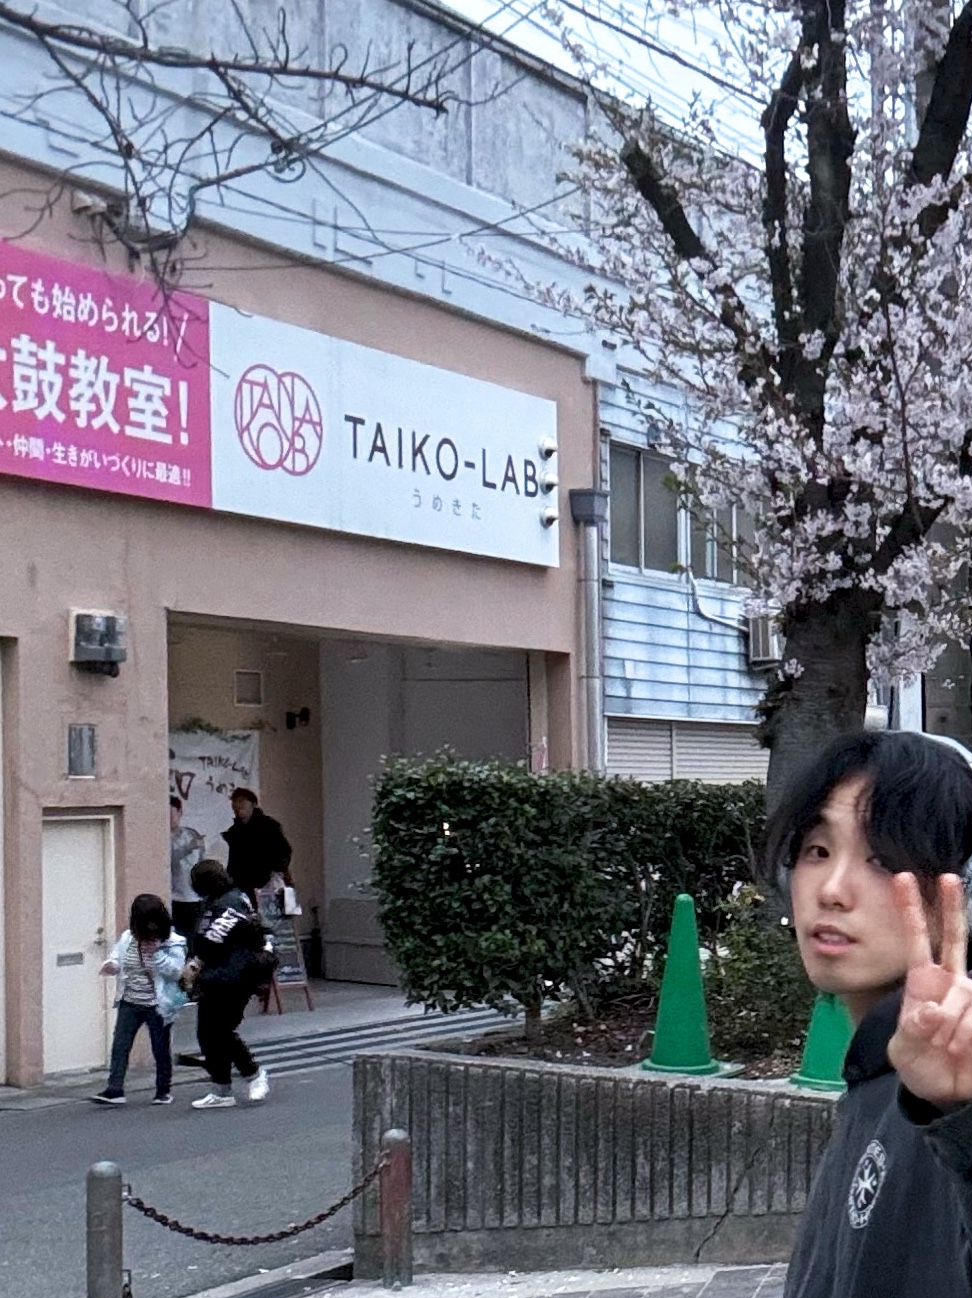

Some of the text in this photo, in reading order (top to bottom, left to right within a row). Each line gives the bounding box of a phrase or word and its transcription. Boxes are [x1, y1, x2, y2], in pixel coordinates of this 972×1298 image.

[0, 333, 189, 446] 鼓教室!
[344, 414, 539, 498] TAIKO-LAB
[412, 488, 482, 521] うめきた
